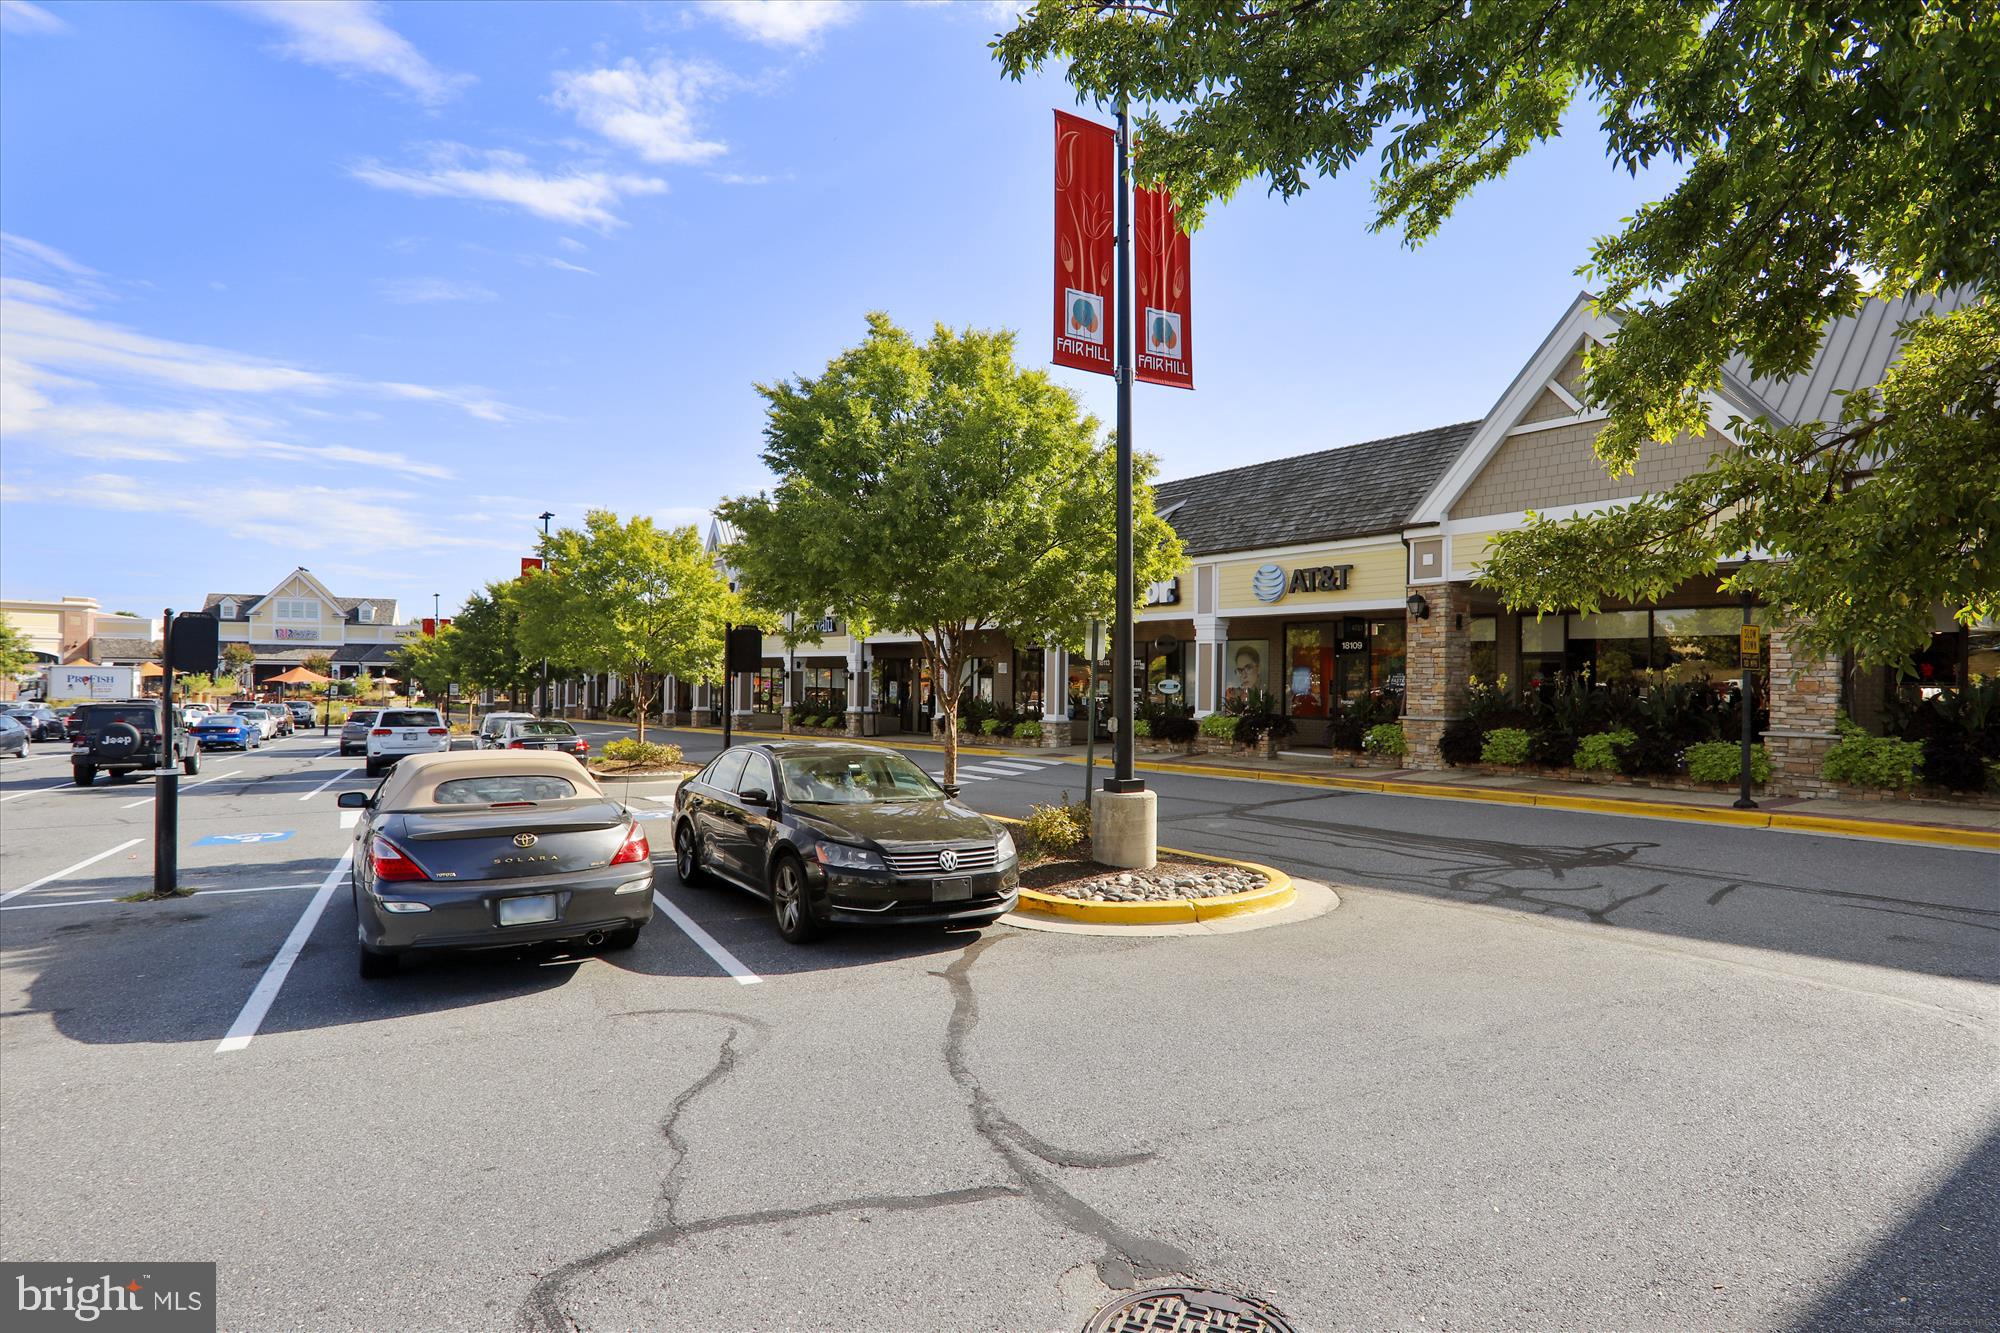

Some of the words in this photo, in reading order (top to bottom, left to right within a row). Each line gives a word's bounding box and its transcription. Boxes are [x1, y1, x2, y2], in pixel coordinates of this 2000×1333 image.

[1057, 337, 1084, 357] FAIR
[1085, 344, 1111, 362] HILL
[1138, 354, 1163, 372] FAIR
[1164, 360, 1189, 376] HILL
[1288, 564, 1354, 593] AT&T
[1743, 628, 1756, 638] SLOW
[1342, 641, 1363, 650] 18109
[1743, 640, 1757, 650] DOWN
[101, 736, 132, 746] Jeep
[493, 854, 559, 864] SOLARA
